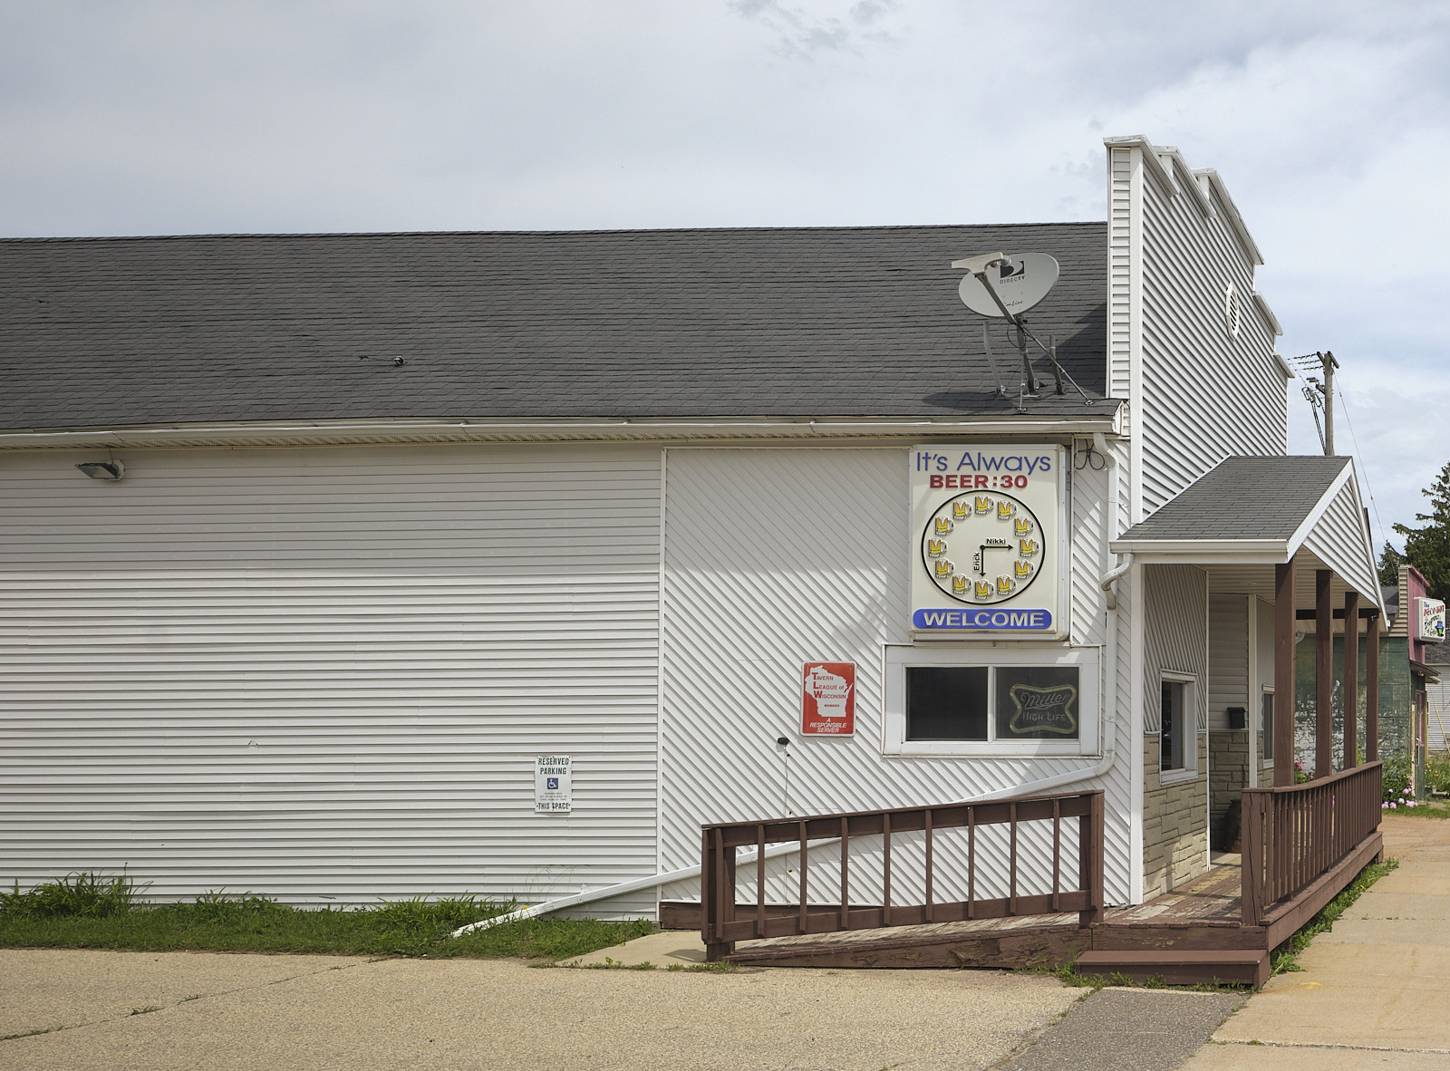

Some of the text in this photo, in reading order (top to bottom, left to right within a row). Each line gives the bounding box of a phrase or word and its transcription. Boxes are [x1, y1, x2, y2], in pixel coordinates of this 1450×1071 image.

[916, 451, 1052, 475] It's Always
[929, 474, 1028, 489] BEER:30
[973, 552, 981, 571] Erick
[923, 611, 1045, 627] WELCOME
[538, 757, 570, 766] RESERVED
[540, 767, 567, 775] PARKING
